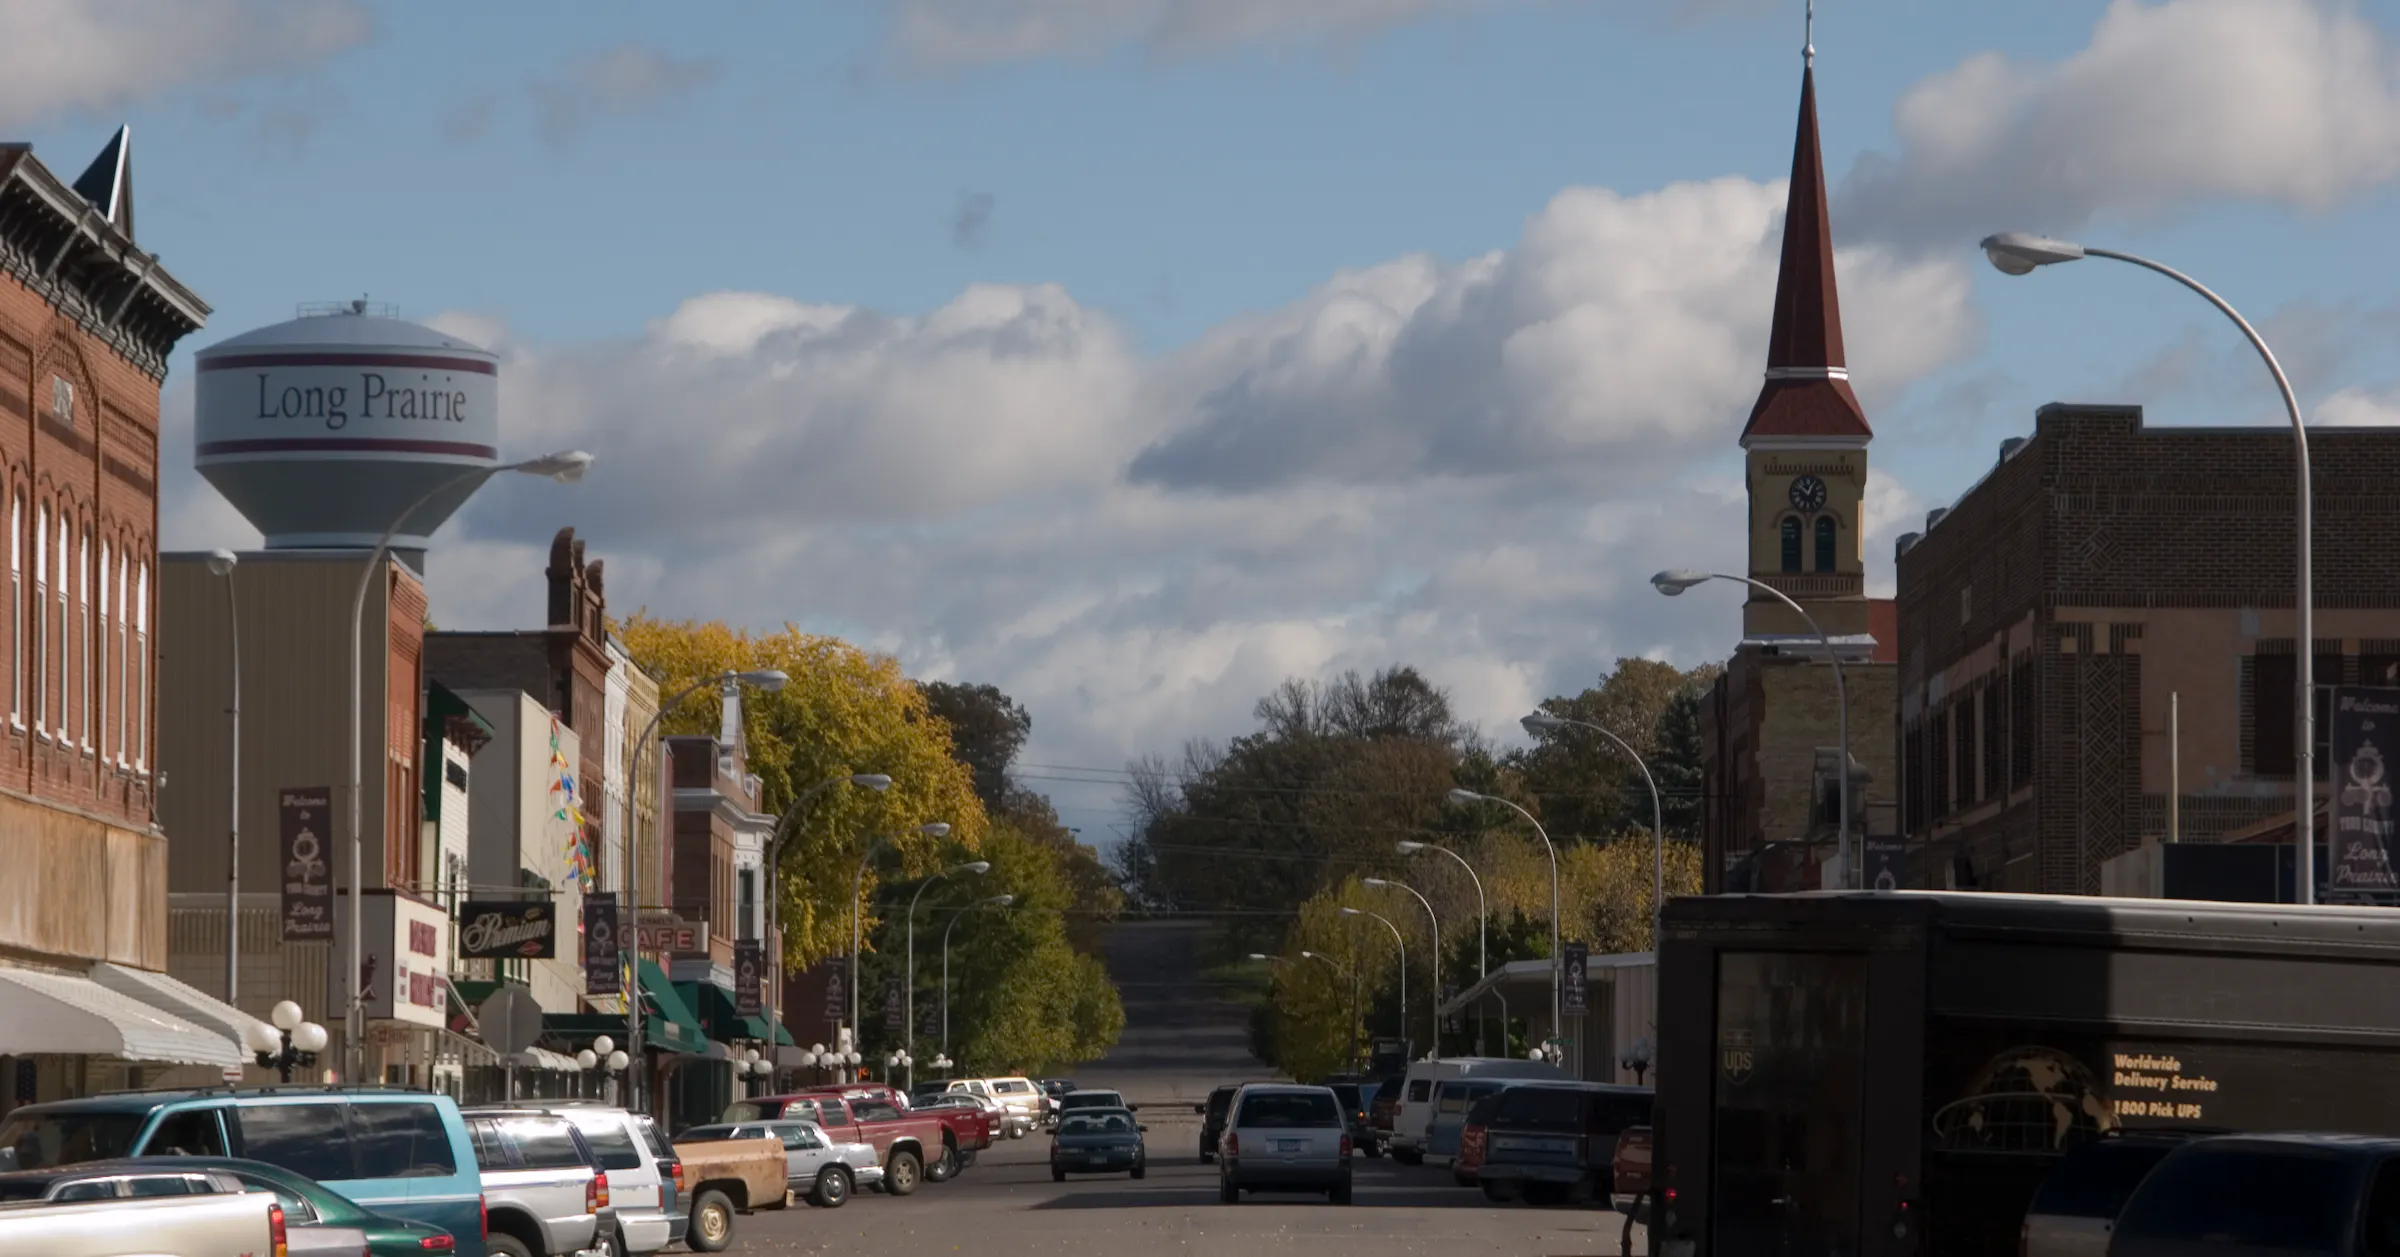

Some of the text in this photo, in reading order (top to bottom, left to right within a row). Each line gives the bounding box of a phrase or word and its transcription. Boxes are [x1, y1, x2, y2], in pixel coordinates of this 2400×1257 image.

[257, 373, 466, 430] Long Prairie
[2340, 696, 2399, 714] Welcome
[288, 901, 325, 920] Long
[462, 912, 552, 953] Premium
[619, 924, 695, 952] CAFE
[1725, 1050, 1752, 1077] ups
[2114, 1054, 2181, 1071] Worldwide
[2114, 1072, 2217, 1091] Delivery Service
[2148, 1102, 2174, 1118] Pick
[2177, 1103, 2202, 1119] UPS
